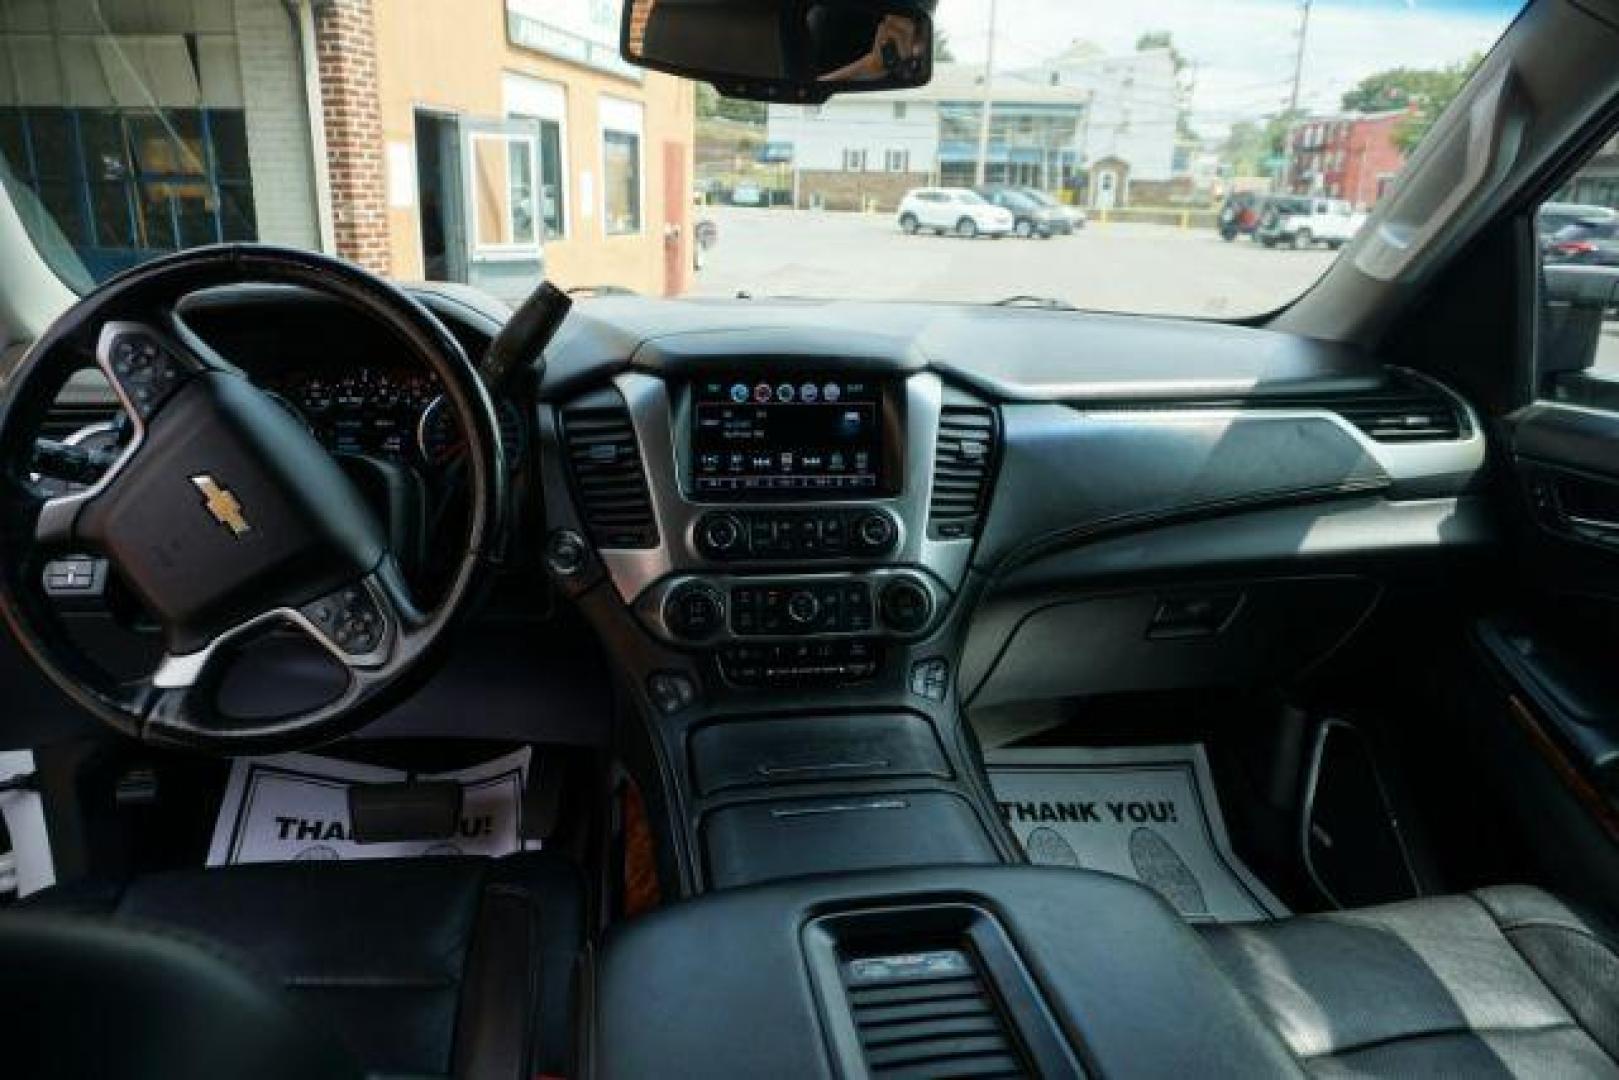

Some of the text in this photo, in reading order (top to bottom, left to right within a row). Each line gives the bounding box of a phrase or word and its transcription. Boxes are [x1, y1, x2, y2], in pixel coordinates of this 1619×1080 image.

[999, 801, 1177, 822] THANK YOU!
[275, 816, 347, 841] THA
